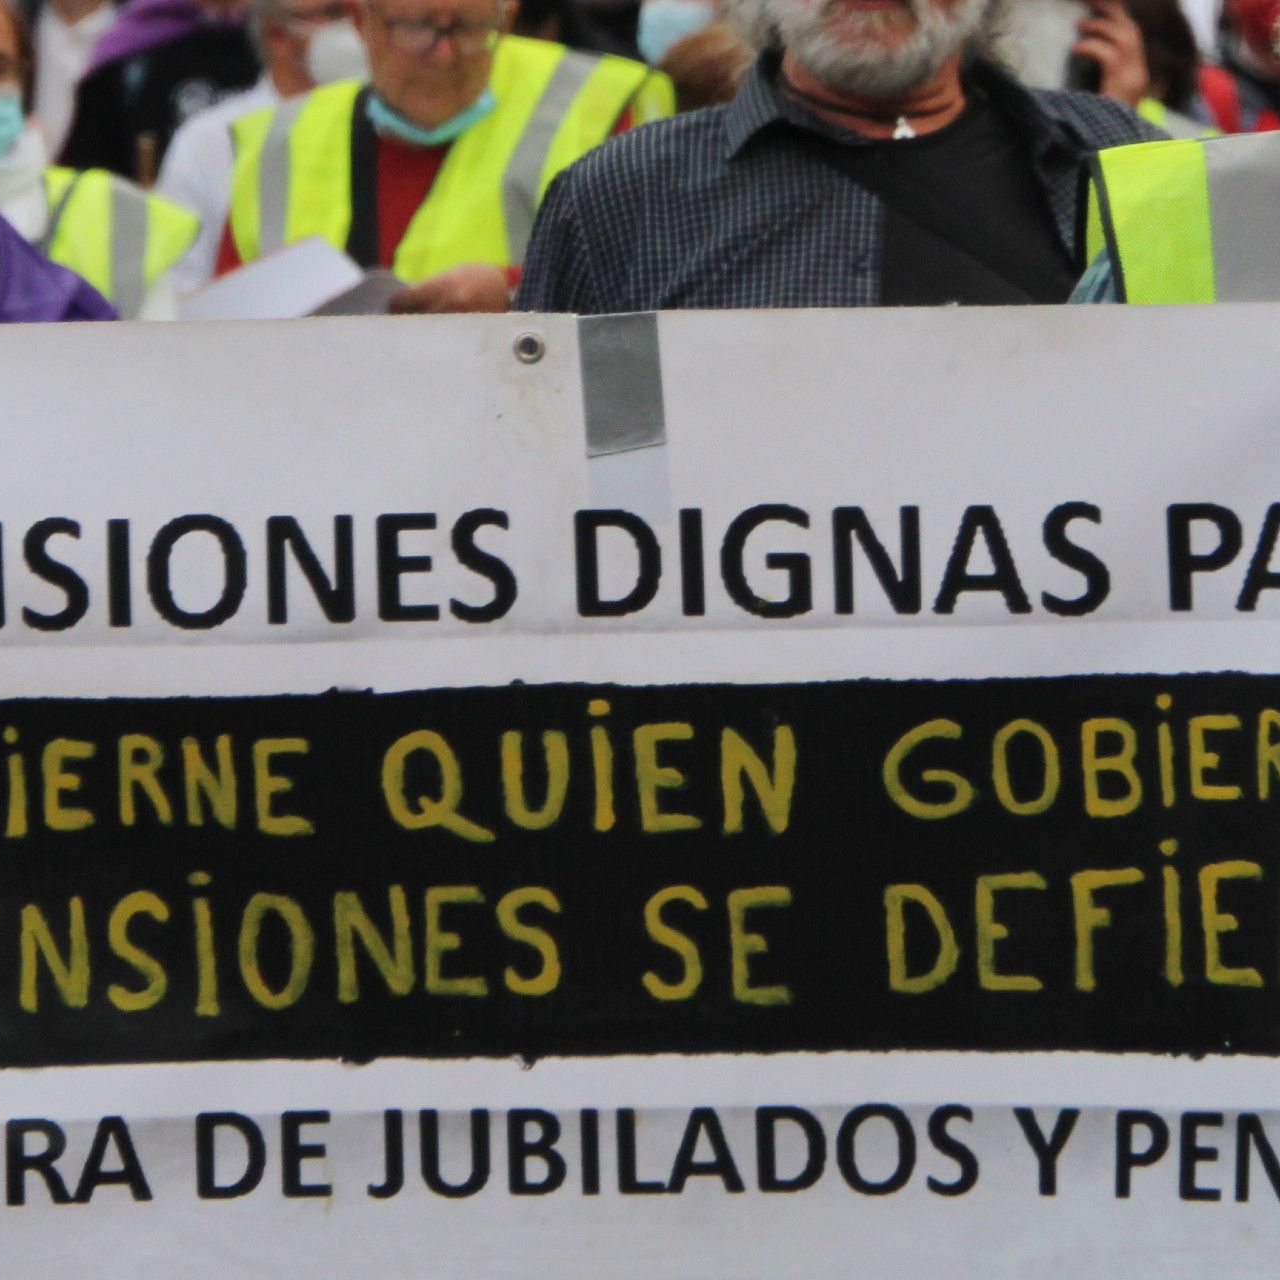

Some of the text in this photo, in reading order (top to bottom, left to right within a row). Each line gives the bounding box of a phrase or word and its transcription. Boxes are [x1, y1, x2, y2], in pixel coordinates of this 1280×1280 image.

[573, 500, 1112, 620] DIGNAS
[641, 883, 793, 1006] SE
[194, 1109, 334, 1201] DE
[366, 1102, 980, 1200] JUBILADOS
[1011, 1106, 1082, 1197] Y
